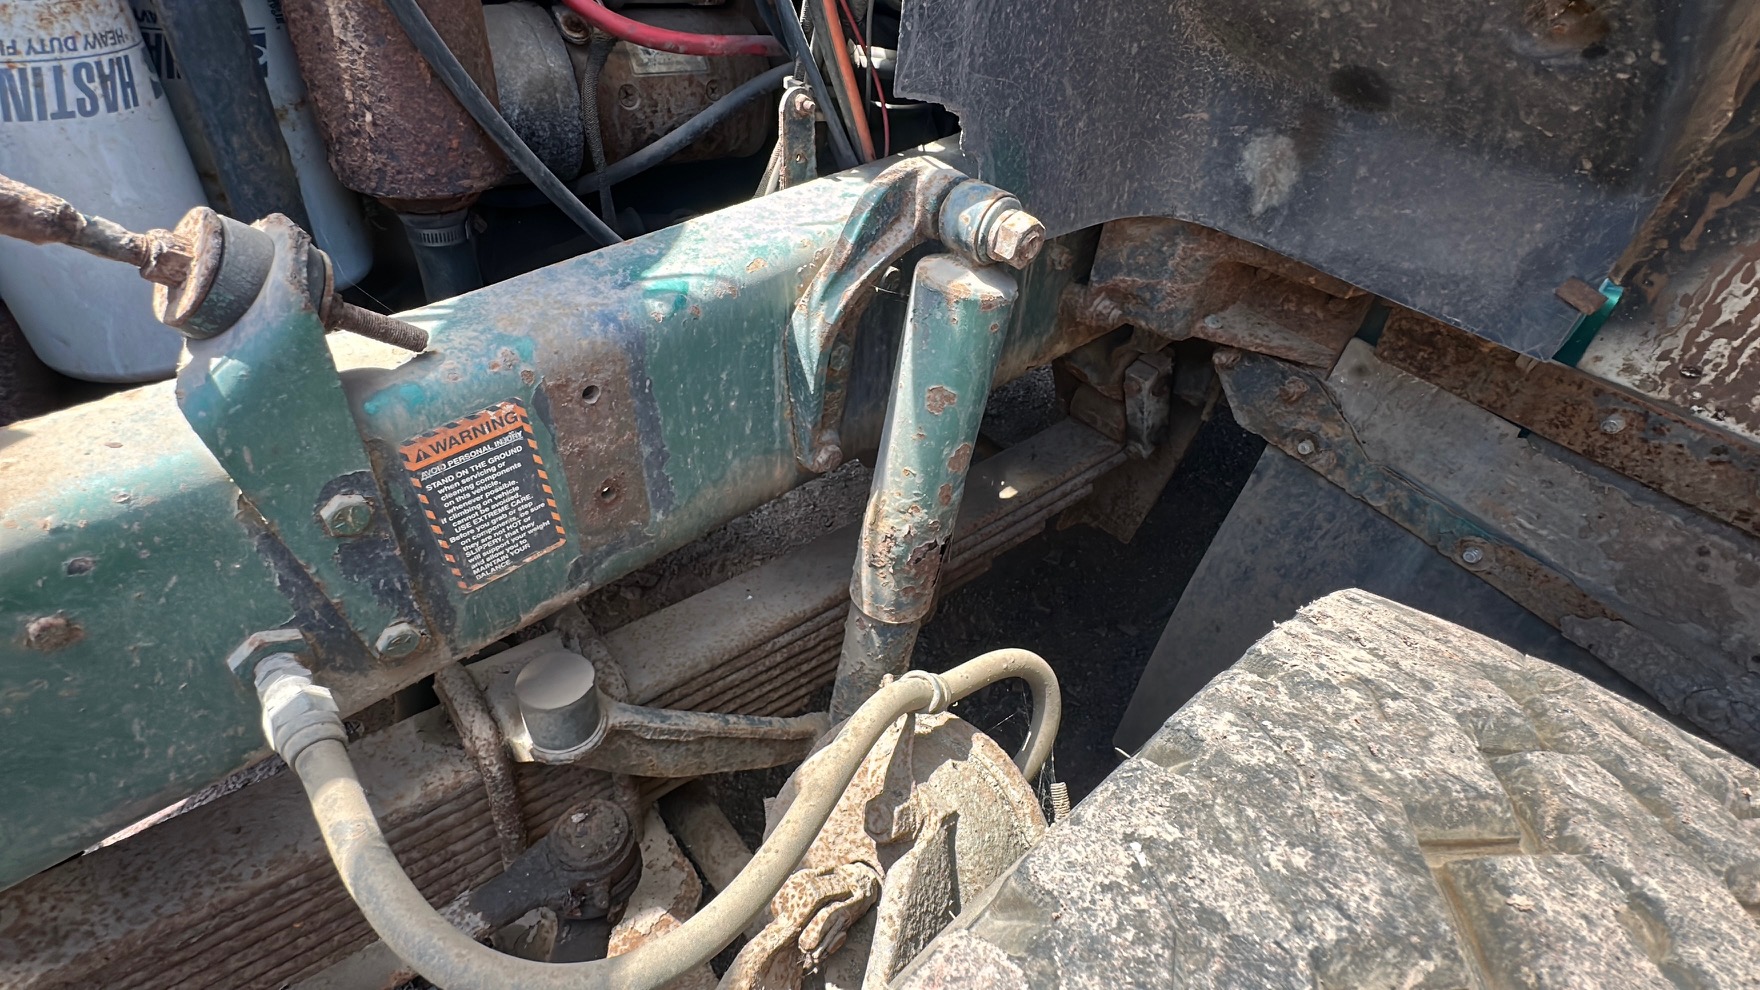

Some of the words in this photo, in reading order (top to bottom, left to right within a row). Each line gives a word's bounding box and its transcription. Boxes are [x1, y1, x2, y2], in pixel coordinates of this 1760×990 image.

[26, 35, 78, 55] DUTY
[429, 411, 518, 455] WARNING
[421, 463, 447, 479] AVOID
[447, 444, 493, 468] PERSONAL
[425, 475, 455, 492] STAND
[455, 468, 469, 479] ON
[470, 460, 487, 472] THE
[487, 445, 523, 465] GROUND
[437, 481, 460, 495] when
[461, 465, 497, 485] servicing
[497, 461, 506, 469] or
[440, 483, 475, 501] cleaning
[475, 462, 522, 486] components
[444, 499, 455, 508] on
[455, 493, 471, 503] this
[446, 494, 484, 514] whenever
[448, 503, 482, 521] climbing
[482, 498, 493, 506] on
[493, 486, 520, 501] vehicle
[452, 511, 479, 527] cannot
[480, 507, 490, 515] be
[454, 522, 472, 534] USE
[473, 504, 510, 525] EXTREME
[510, 493, 534, 508] CARE.
[449, 529, 475, 544] Before
[475, 521, 490, 532] you
[490, 513, 508, 525] grab
[517, 501, 533, 512] step
[460, 538, 471, 546] on
[530, 502, 546, 513] sure
[462, 541, 480, 552] they
[480, 535, 493, 544] are
[493, 528, 506, 537] not
[506, 519, 523, 531] HOT
[505, 528, 520, 539] that
[520, 520, 535, 532] they
[468, 553, 482, 564] will
[482, 540, 510, 557] support
[510, 532, 527, 544] your
[527, 520, 551, 535] weight
[471, 559, 485, 570] and
[486, 550, 505, 562] allow
[506, 544, 519, 554] you
[519, 538, 528, 546] to
[473, 553, 510, 575] MAINTAIN
[510, 542, 531, 556] YOUR
